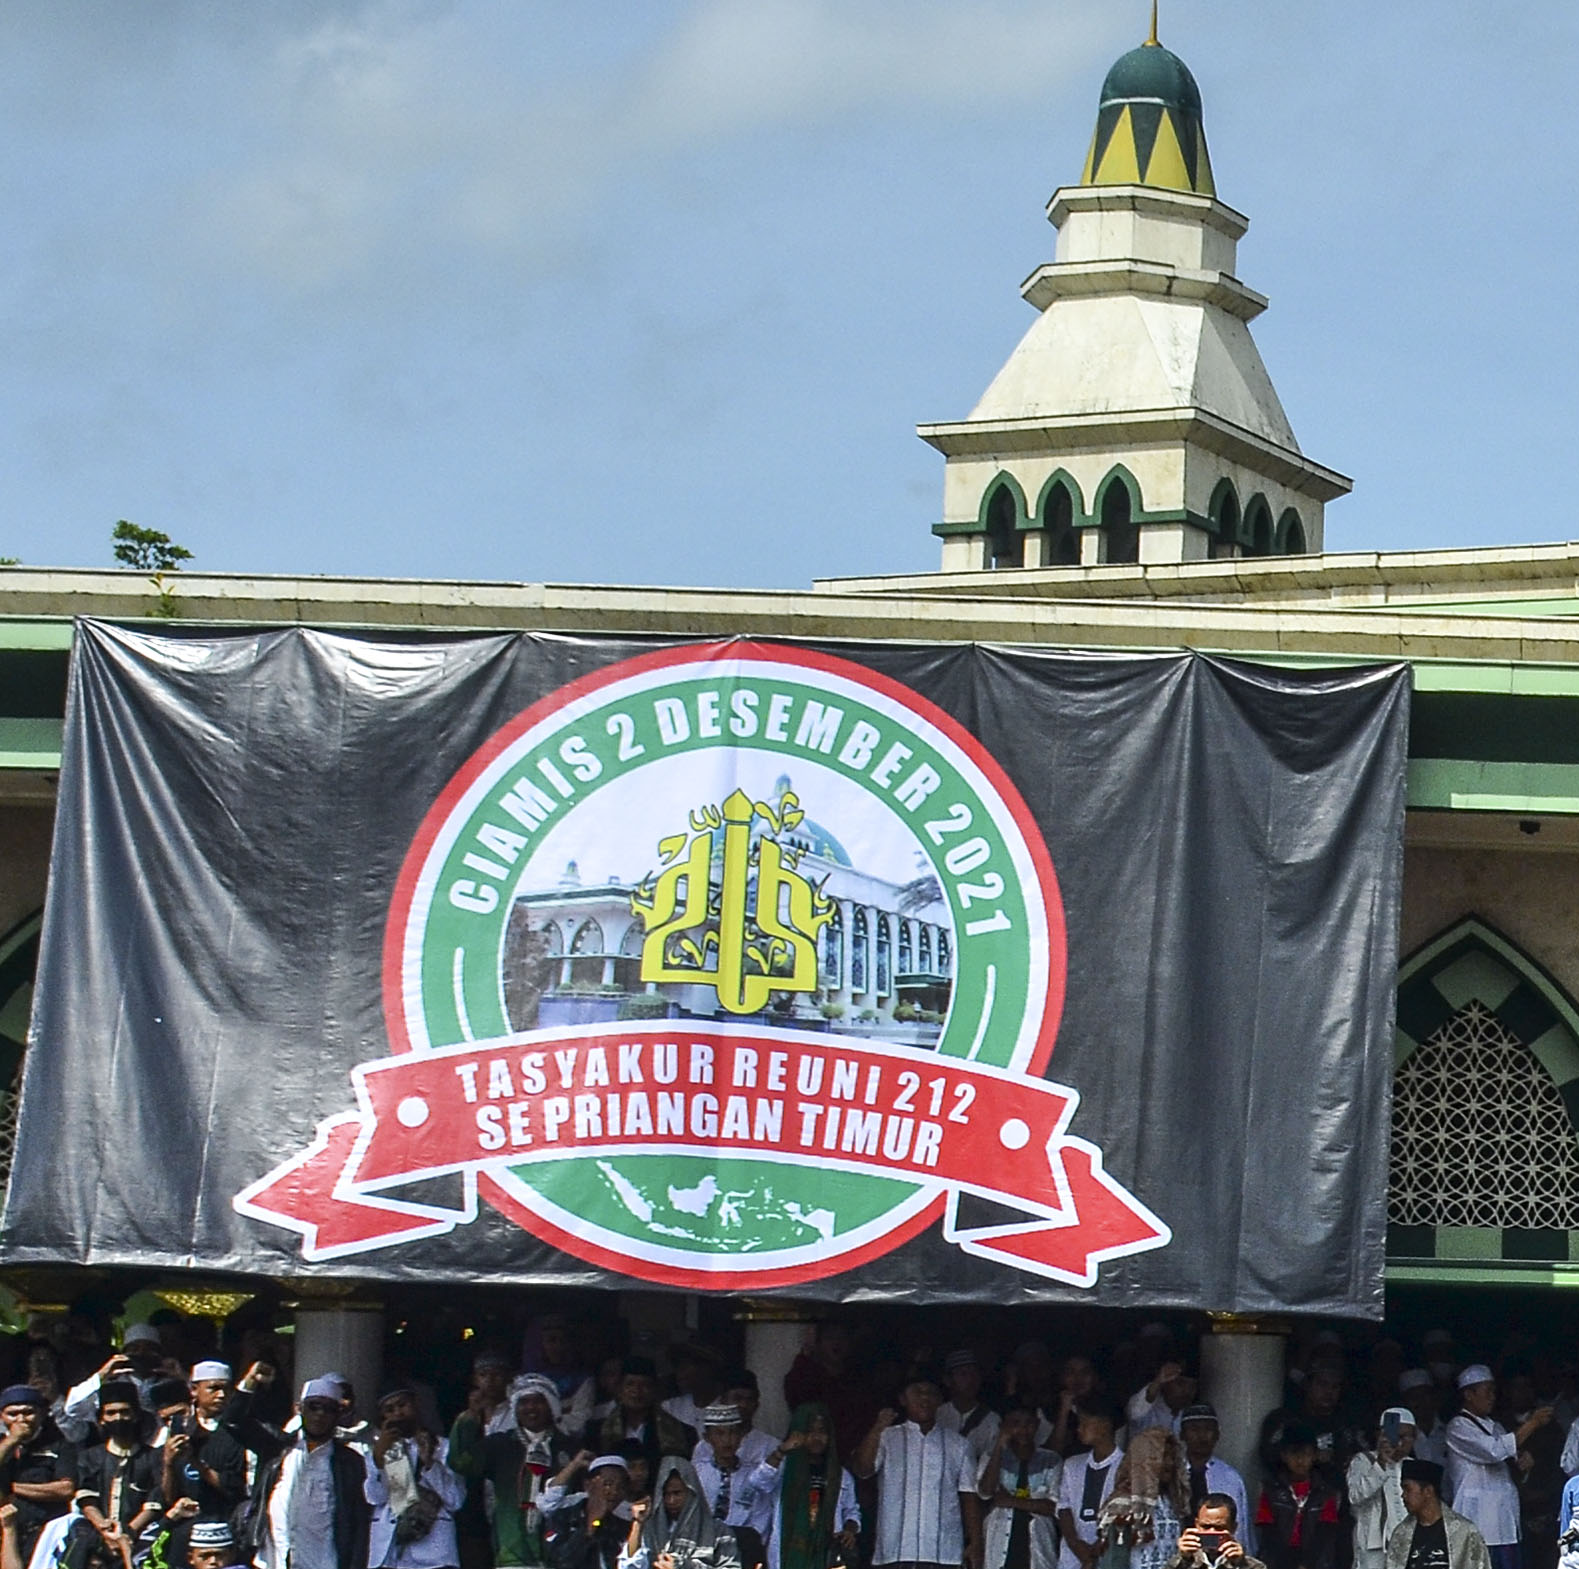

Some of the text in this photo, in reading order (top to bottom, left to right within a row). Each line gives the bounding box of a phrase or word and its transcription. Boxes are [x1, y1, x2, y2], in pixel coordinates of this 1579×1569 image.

[449, 733, 602, 917] CIAMIS
[605, 713, 645, 762] 2
[655, 690, 941, 810] DESEMBER
[921, 804, 1012, 937] 2021
[455, 1043, 976, 1127] TASYAKUR REUNI 212
[476, 1088, 945, 1169] SE PRIANGAN TIMUR
